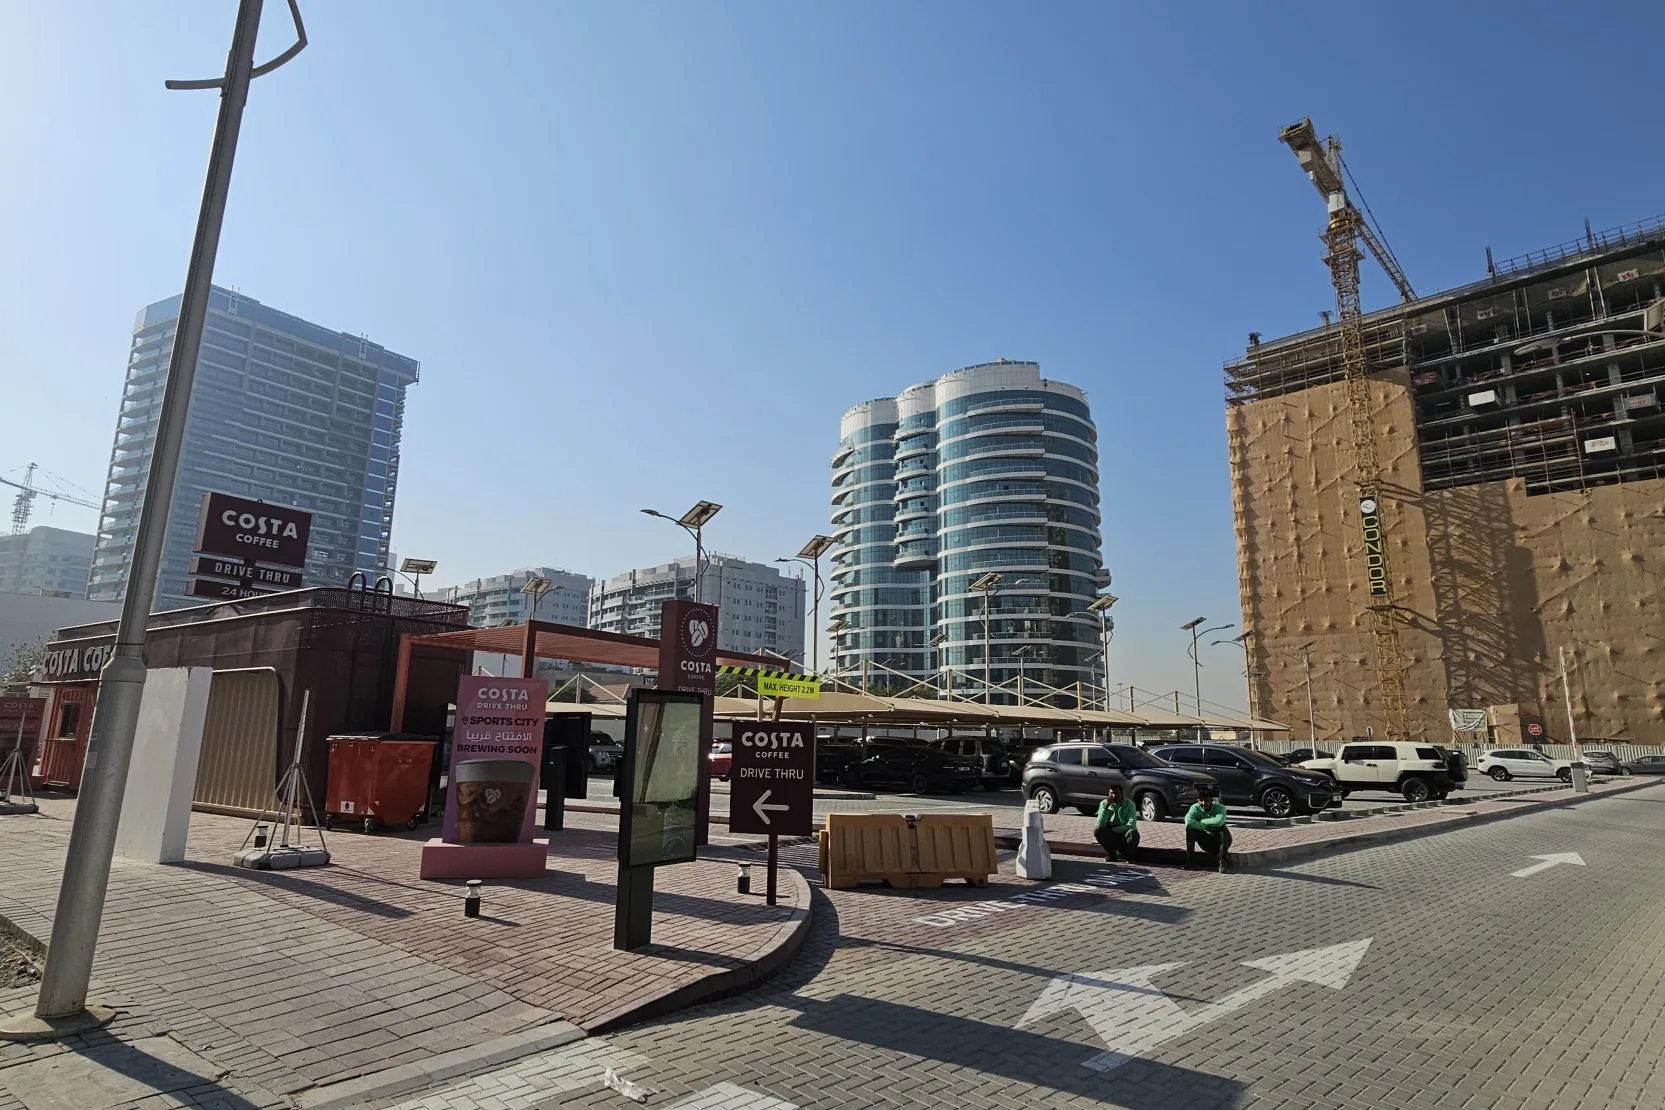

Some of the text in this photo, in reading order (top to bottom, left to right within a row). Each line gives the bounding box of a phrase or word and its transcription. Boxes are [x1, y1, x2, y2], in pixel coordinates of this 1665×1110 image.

[222, 510, 298, 538] COSTA
[236, 533, 279, 549] COFFEE
[1363, 515, 1387, 593] CONDOR
[214, 562, 290, 583] DRIVE THRU
[221, 586, 237, 596] 24
[43, 648, 80, 677] COSTA
[680, 660, 712, 673] COSTA
[477, 687, 529, 702] COSTA
[678, 685, 712, 696] DRIVE THRU
[763, 682, 815, 694] MAX. HEIGHT 2.2M
[504, 703, 528, 711] THRU
[470, 716, 540, 727] SPORTS CITY
[494, 731, 532, 742] الافتتاح
[741, 731, 804, 749] COSTA
[457, 744, 538, 754] BREWING SOON
[755, 751, 790, 759] COFFEE
[740, 767, 804, 780] DRIVE THRU
